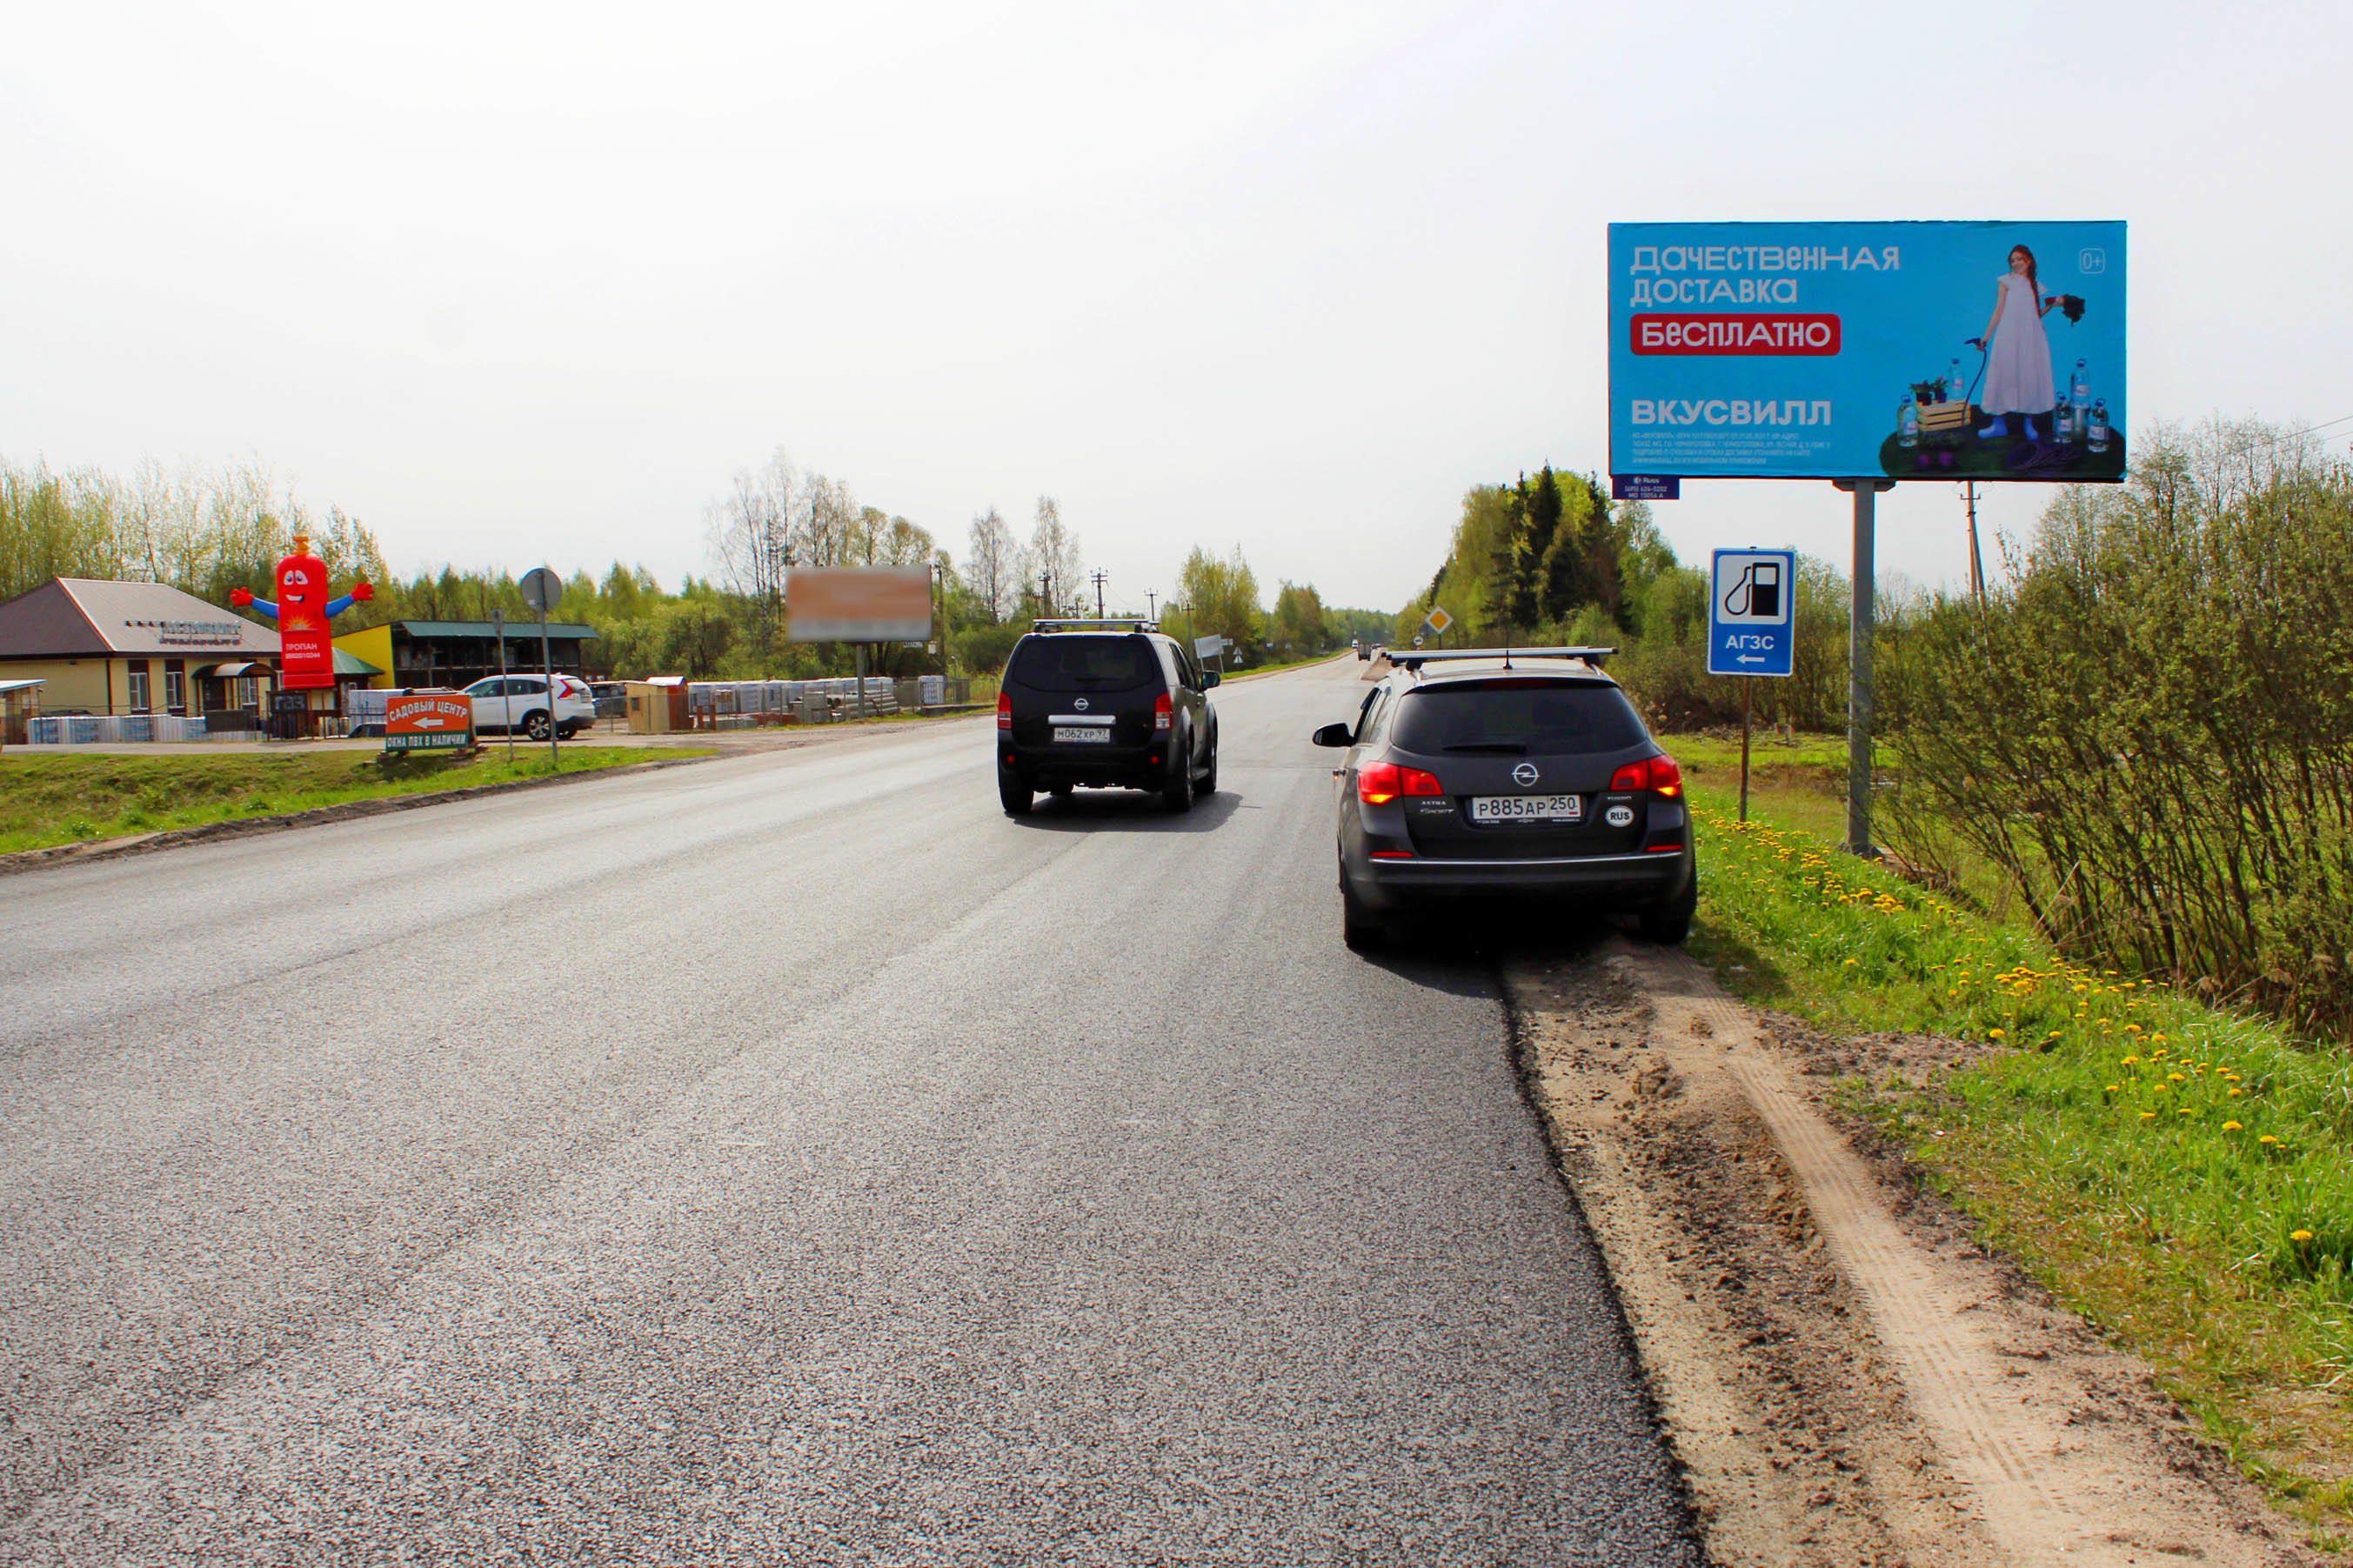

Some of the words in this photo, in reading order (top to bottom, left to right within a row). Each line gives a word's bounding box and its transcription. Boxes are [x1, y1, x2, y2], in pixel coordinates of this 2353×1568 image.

[2082, 251, 2103, 270] 0+
[1629, 278, 1798, 308] ДОСТАВКА
[1641, 322, 1831, 348] БЕСПЛАТНО
[1631, 399, 1832, 425] ВКУСВИЛЛ
[285, 643, 318, 651] ПРОПАН
[1725, 635, 1775, 650] АГЗС
[389, 698, 436, 722] САДОВЫЙ
[437, 701, 468, 717] ЦЕНТР
[387, 737, 407, 748] ОКНА
[408, 736, 424, 747] ПВХ
[424, 736, 431, 746] В
[431, 734, 467, 745] НАЛИЧИИ
[1549, 797, 1576, 811] 250
[1610, 811, 1630, 820] RUS
